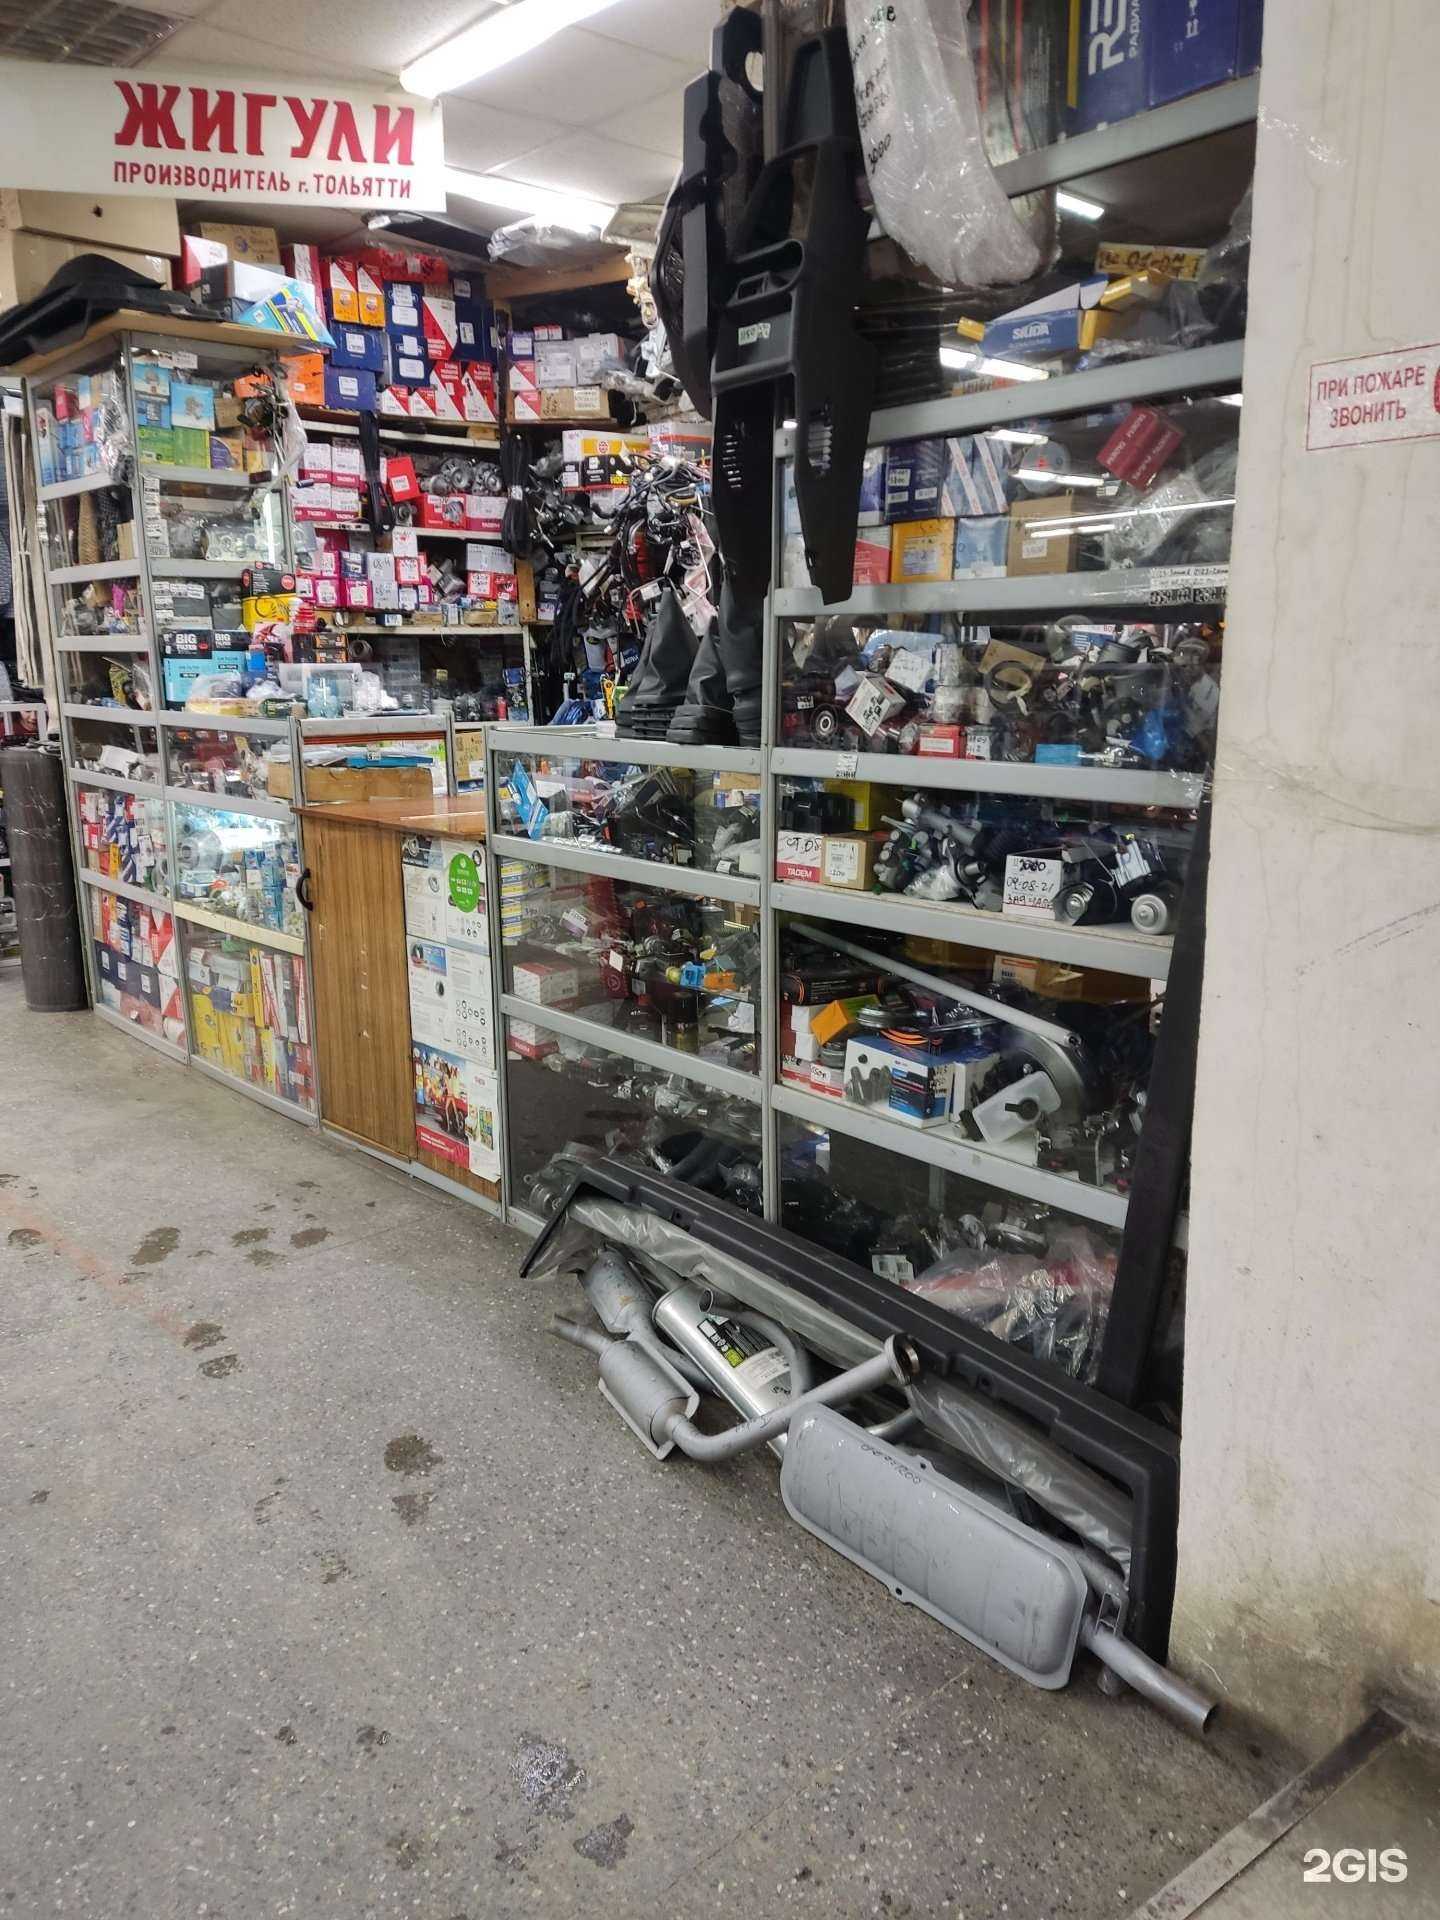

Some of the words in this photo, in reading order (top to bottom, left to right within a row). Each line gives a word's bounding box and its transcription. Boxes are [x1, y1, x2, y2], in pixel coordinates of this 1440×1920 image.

[113, 80, 415, 166] ЖИГУЛИ
[113, 161, 290, 193] ПРОИЗВОДИТЕЛЬ
[314, 173, 412, 199] ТОЛЬЯТТИ
[1317, 377, 1348, 400] ПРИ
[1353, 366, 1426, 395] ПОЖАРЕ
[1329, 400, 1407, 429] ЗВОНИТЬ
[176, 634, 197, 644] BIG
[214, 633, 231, 641] BIG
